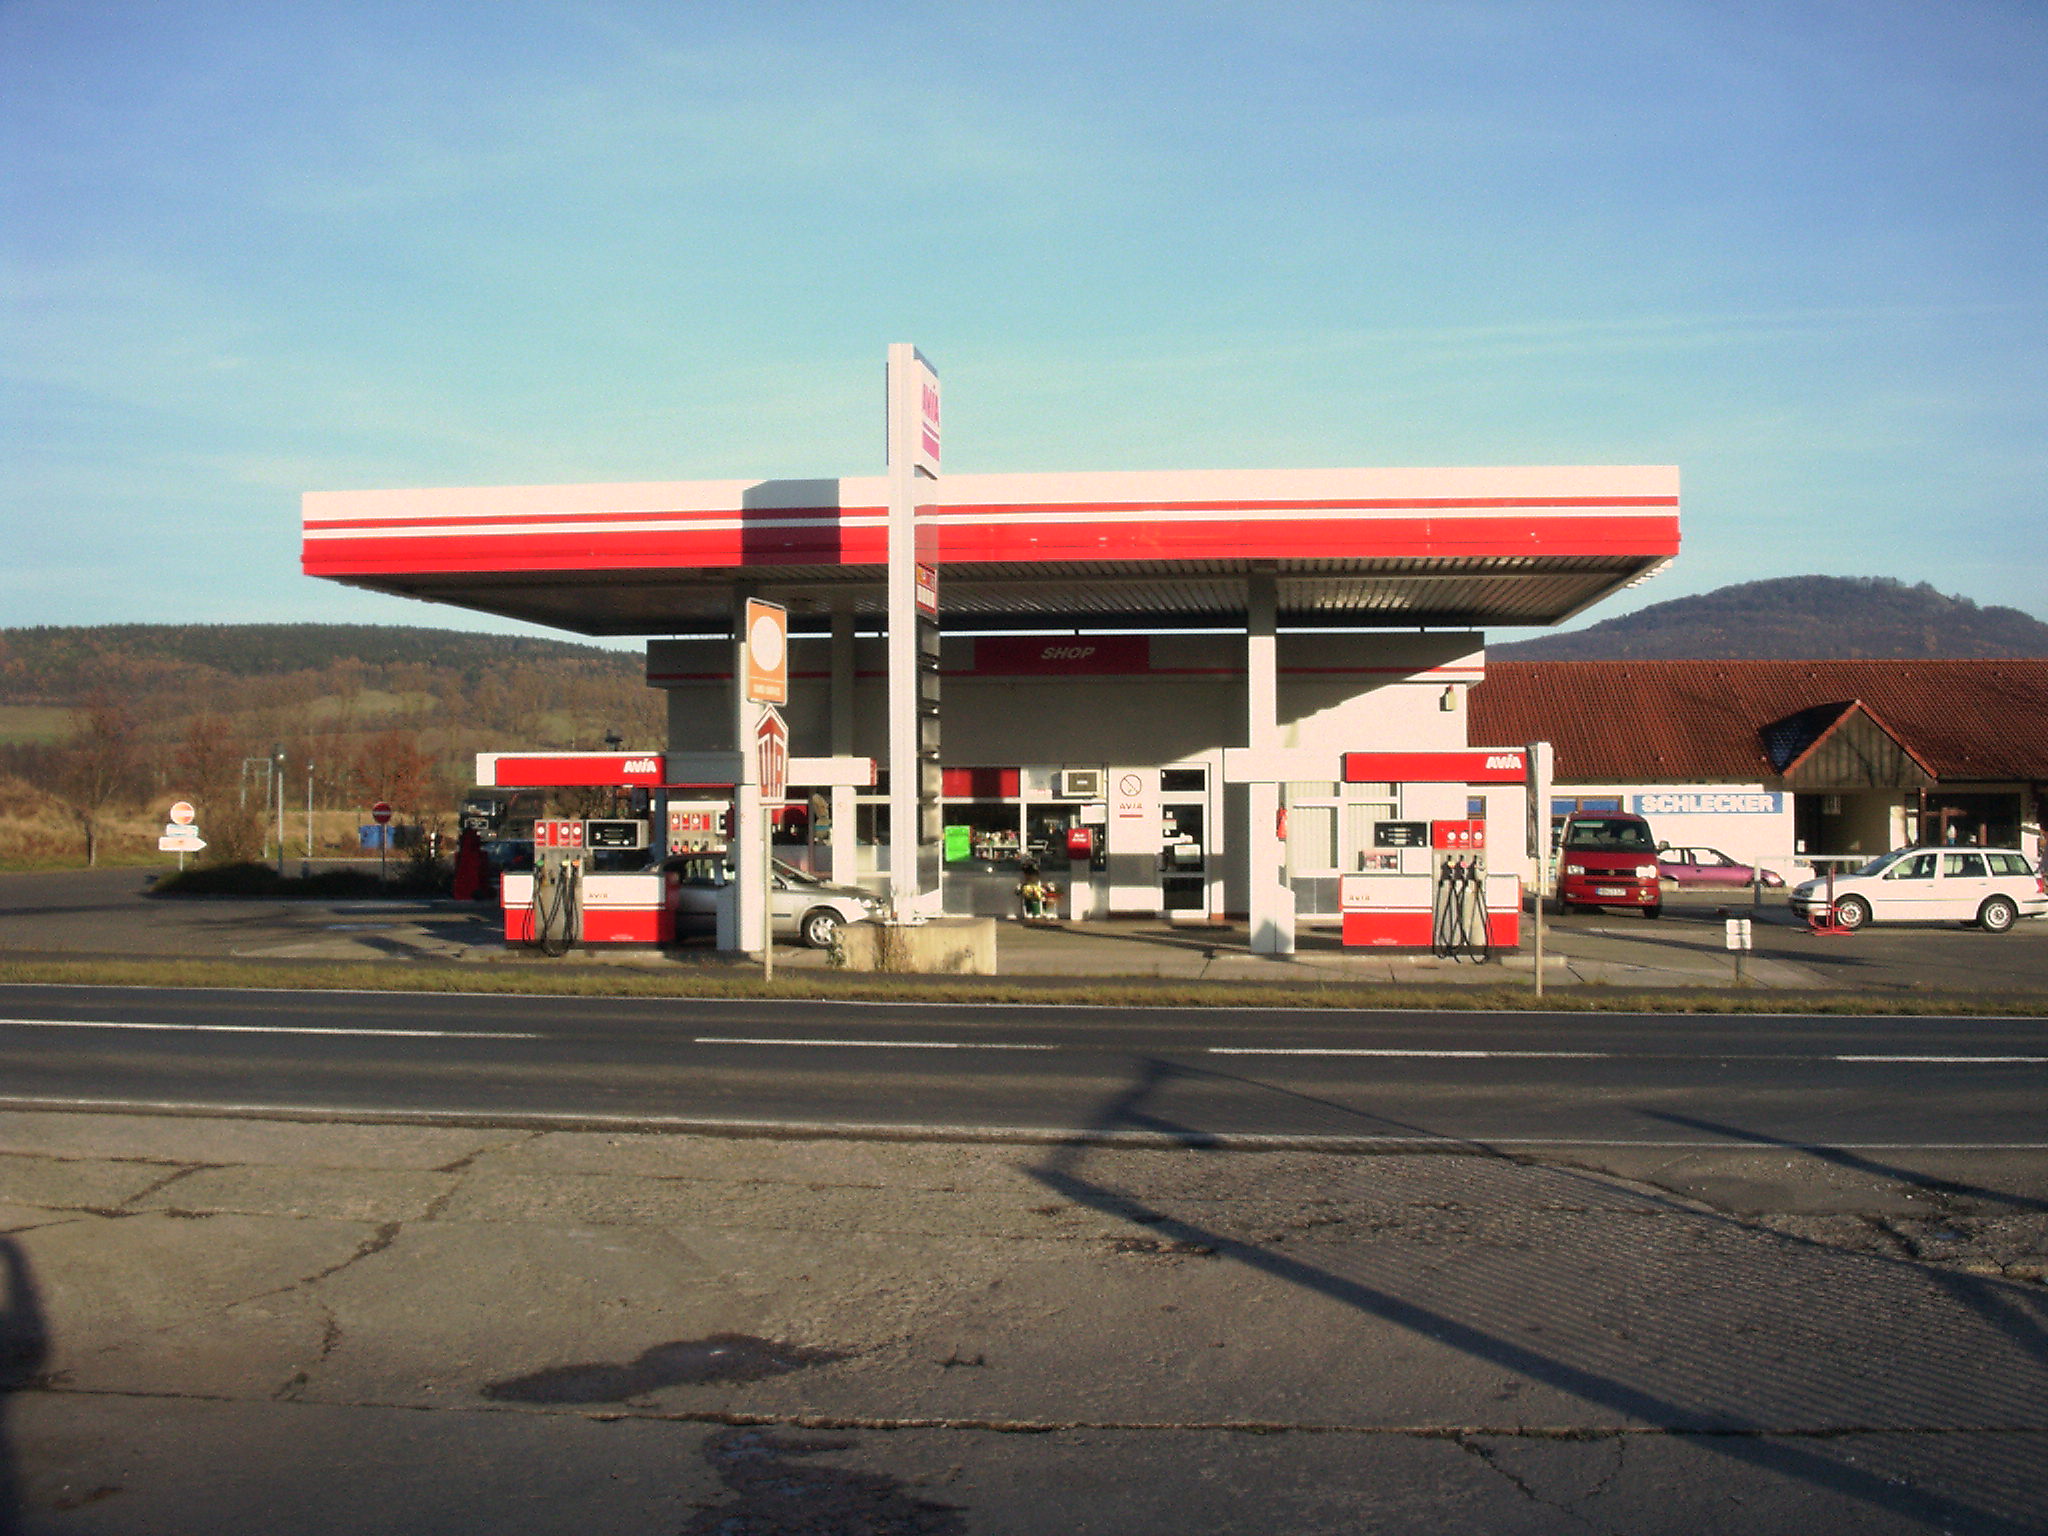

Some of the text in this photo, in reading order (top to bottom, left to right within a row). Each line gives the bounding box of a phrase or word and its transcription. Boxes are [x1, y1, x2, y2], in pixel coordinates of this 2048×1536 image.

[1041, 647, 1095, 659] SHOP
[623, 758, 657, 773] AVIA
[1486, 753, 1522, 769] AVIA
[1641, 794, 1774, 813] SCHLECKER
